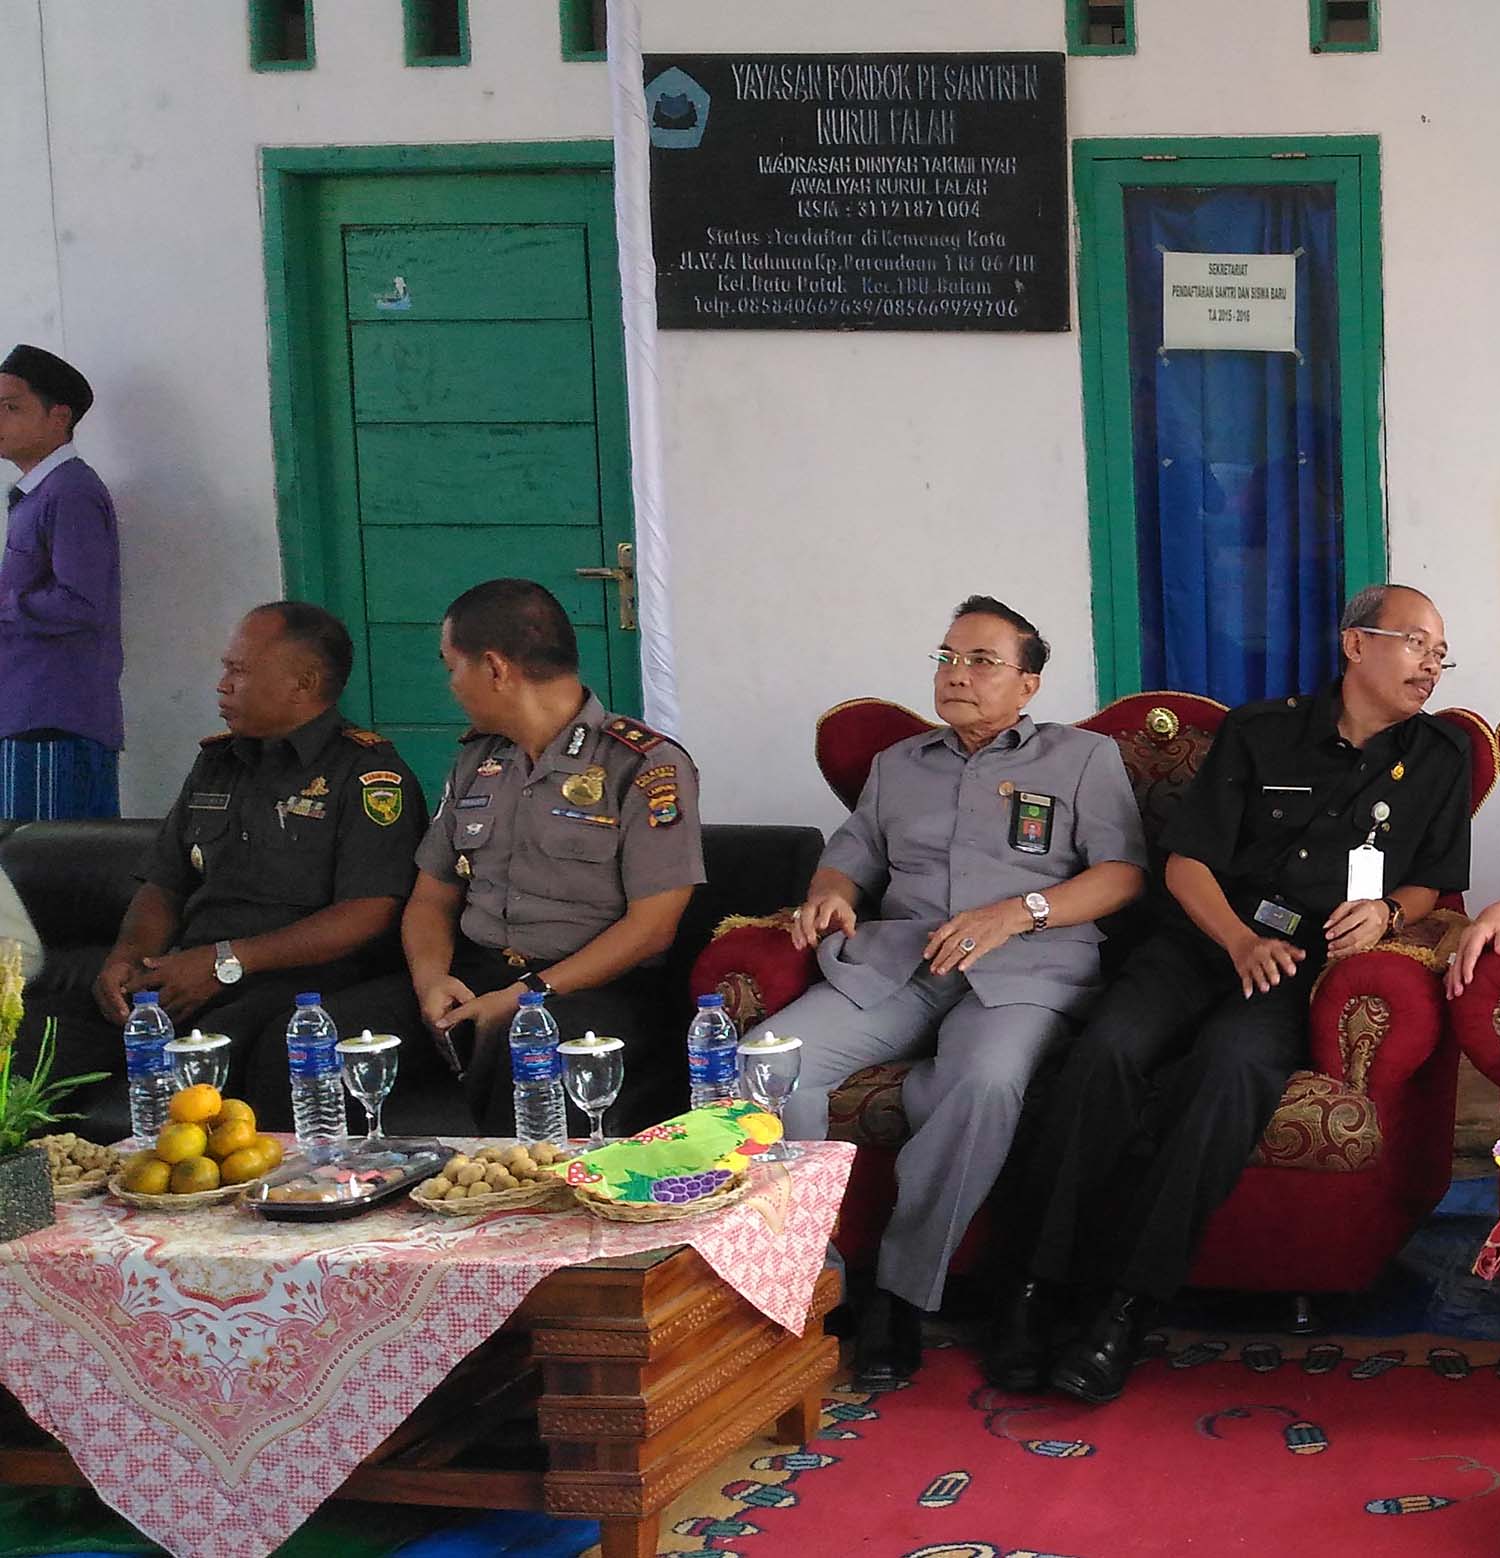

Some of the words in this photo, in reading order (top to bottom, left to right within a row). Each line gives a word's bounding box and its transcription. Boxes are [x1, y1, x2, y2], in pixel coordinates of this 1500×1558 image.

[731, 63, 821, 101] YAYASAN
[827, 63, 912, 100] PONDOK
[917, 64, 1039, 101] PESANTREN
[816, 108, 880, 144] NURUL
[889, 108, 956, 145] FALAH
[758, 155, 850, 174] MADRASAH
[855, 155, 917, 174] DINIYAH
[921, 156, 1017, 174] TAKMILIYAH
[789, 177, 871, 196] AWALIYAH
[876, 178, 933, 196] NURUL
[935, 178, 988, 196] FALAH
[797, 200, 839, 218] NSM
[706, 226, 760, 245] Status
[860, 228, 877, 247] di
[881, 229, 961, 250] Kemenag
[967, 229, 1007, 247] Kota
[1208, 262, 1249, 276] SEKRETARIAT
[1171, 285, 1214, 298] PENDAFTARAN
[1215, 286, 1237, 299] SANTRI
[1238, 286, 1250, 299] DAN
[1251, 287, 1270, 300] SISWA
[1271, 287, 1287, 300] BARU
